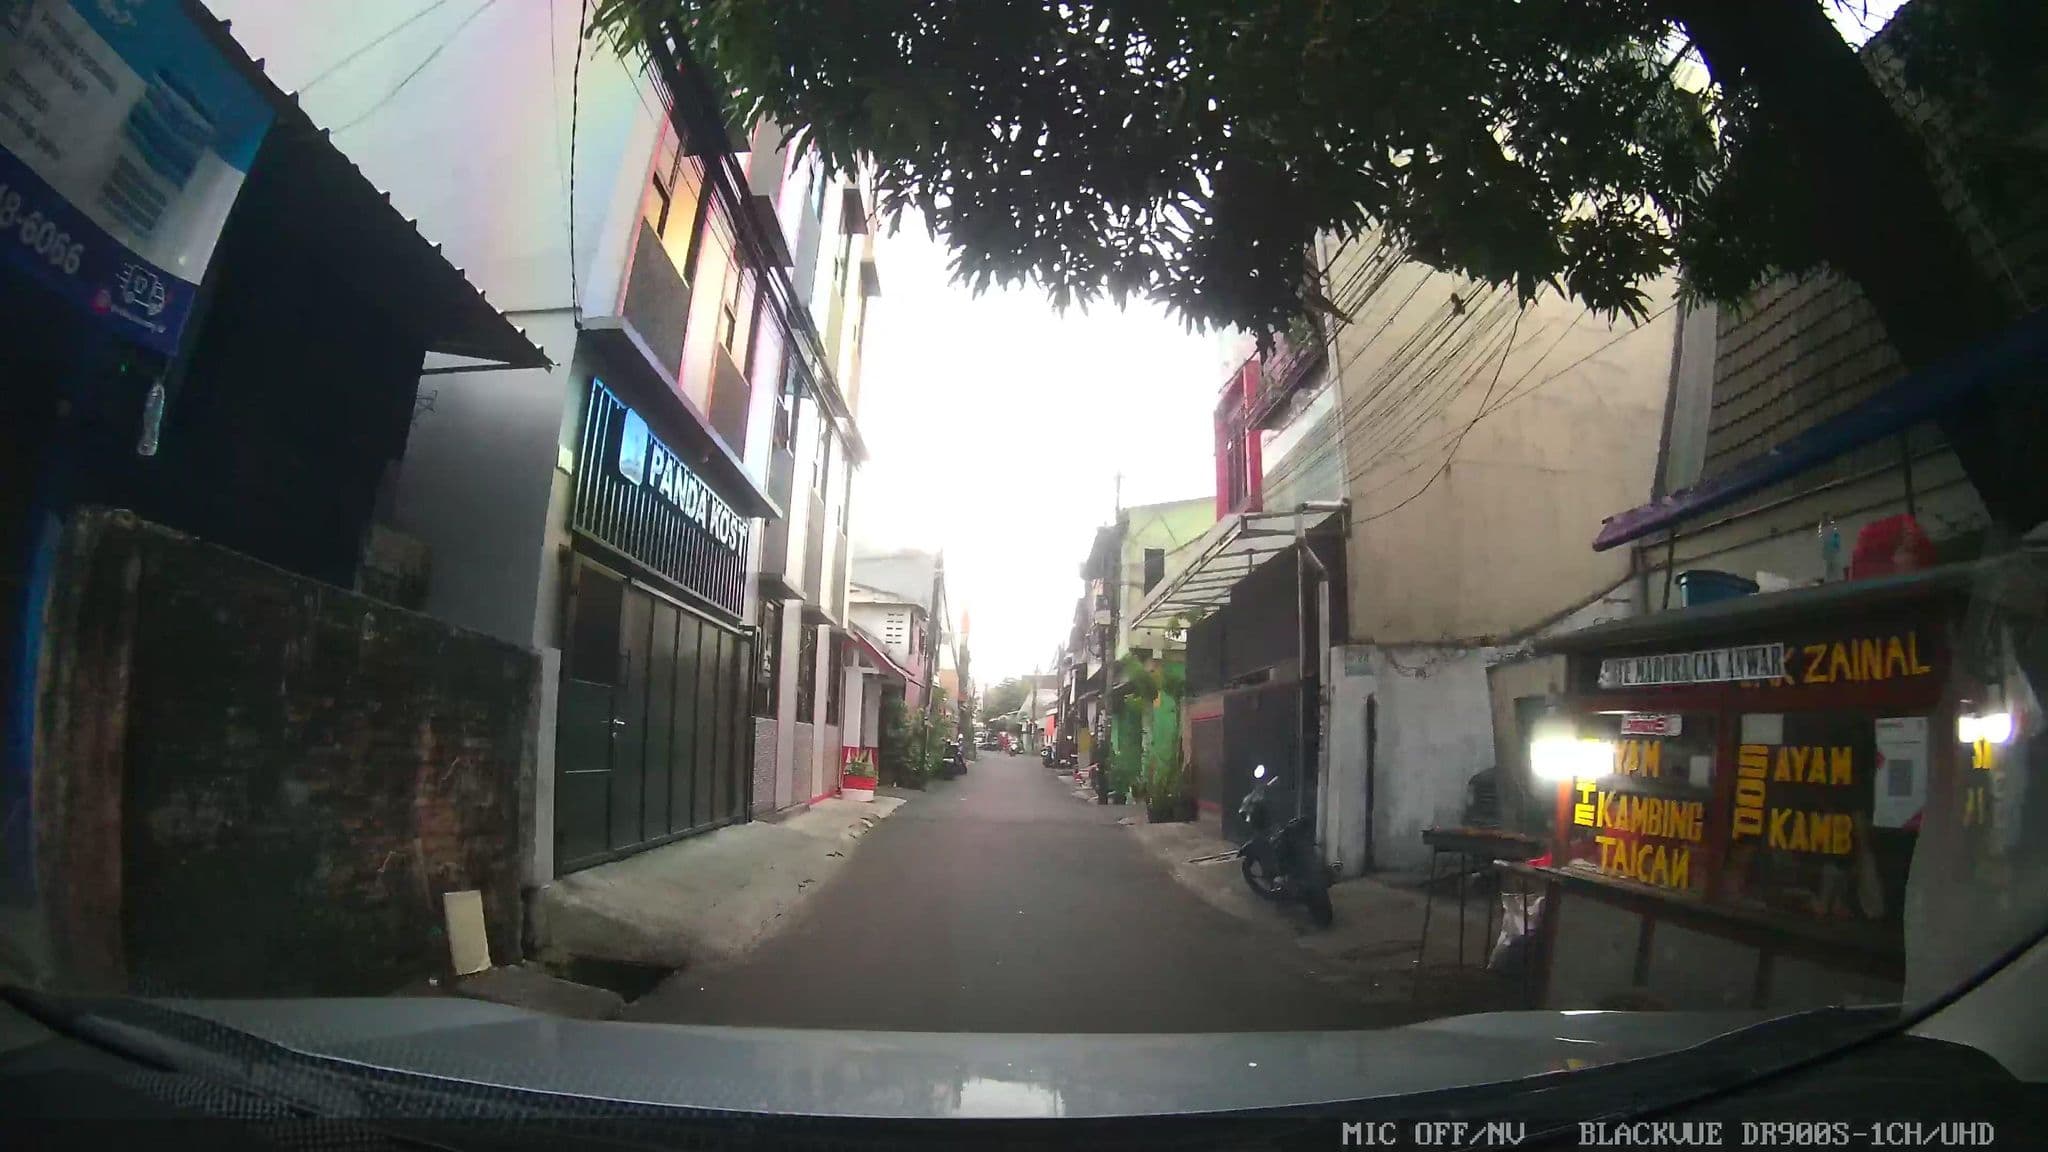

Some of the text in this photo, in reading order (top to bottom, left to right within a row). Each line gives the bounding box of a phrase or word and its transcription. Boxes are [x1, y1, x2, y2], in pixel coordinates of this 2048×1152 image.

[0, 183, 86, 274] 8-6066
[649, 444, 749, 558] PANDA KOST
[1804, 632, 1931, 683] ZAINAL
[1612, 740, 1661, 778] YAM
[1774, 746, 1852, 785] AYAM
[1596, 790, 1704, 841] KAMBING
